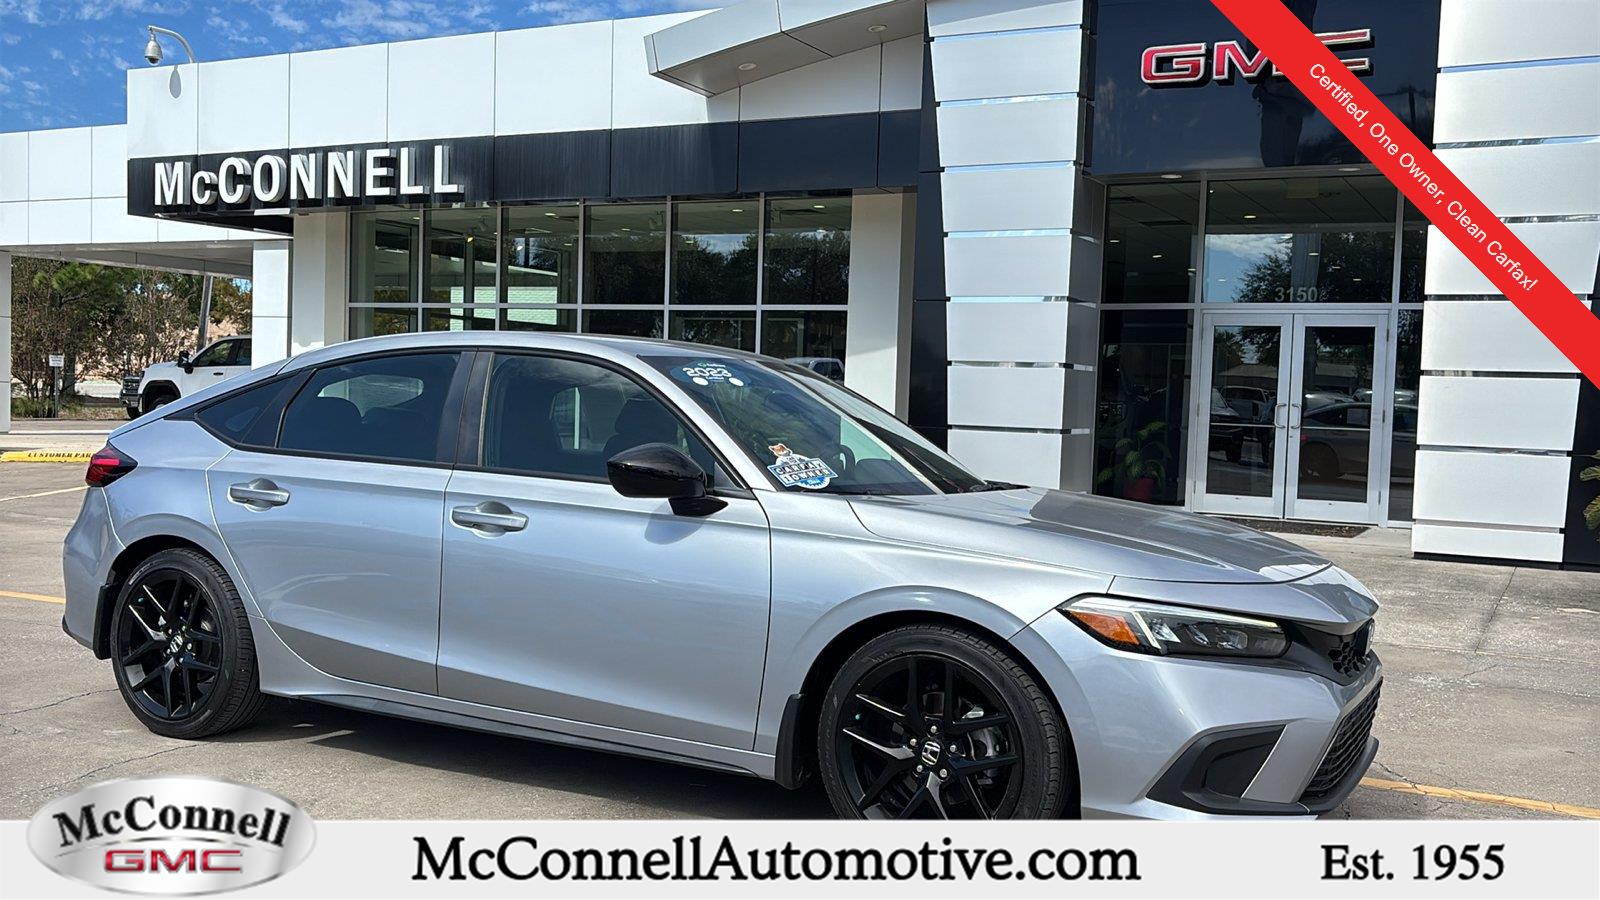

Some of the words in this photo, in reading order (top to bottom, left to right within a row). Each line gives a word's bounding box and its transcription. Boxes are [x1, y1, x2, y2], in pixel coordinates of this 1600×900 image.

[153, 144, 464, 206] McCONNELL
[1274, 286, 1318, 302] 3150
[682, 367, 732, 378] 2023
[775, 461, 827, 475] CARFAX
